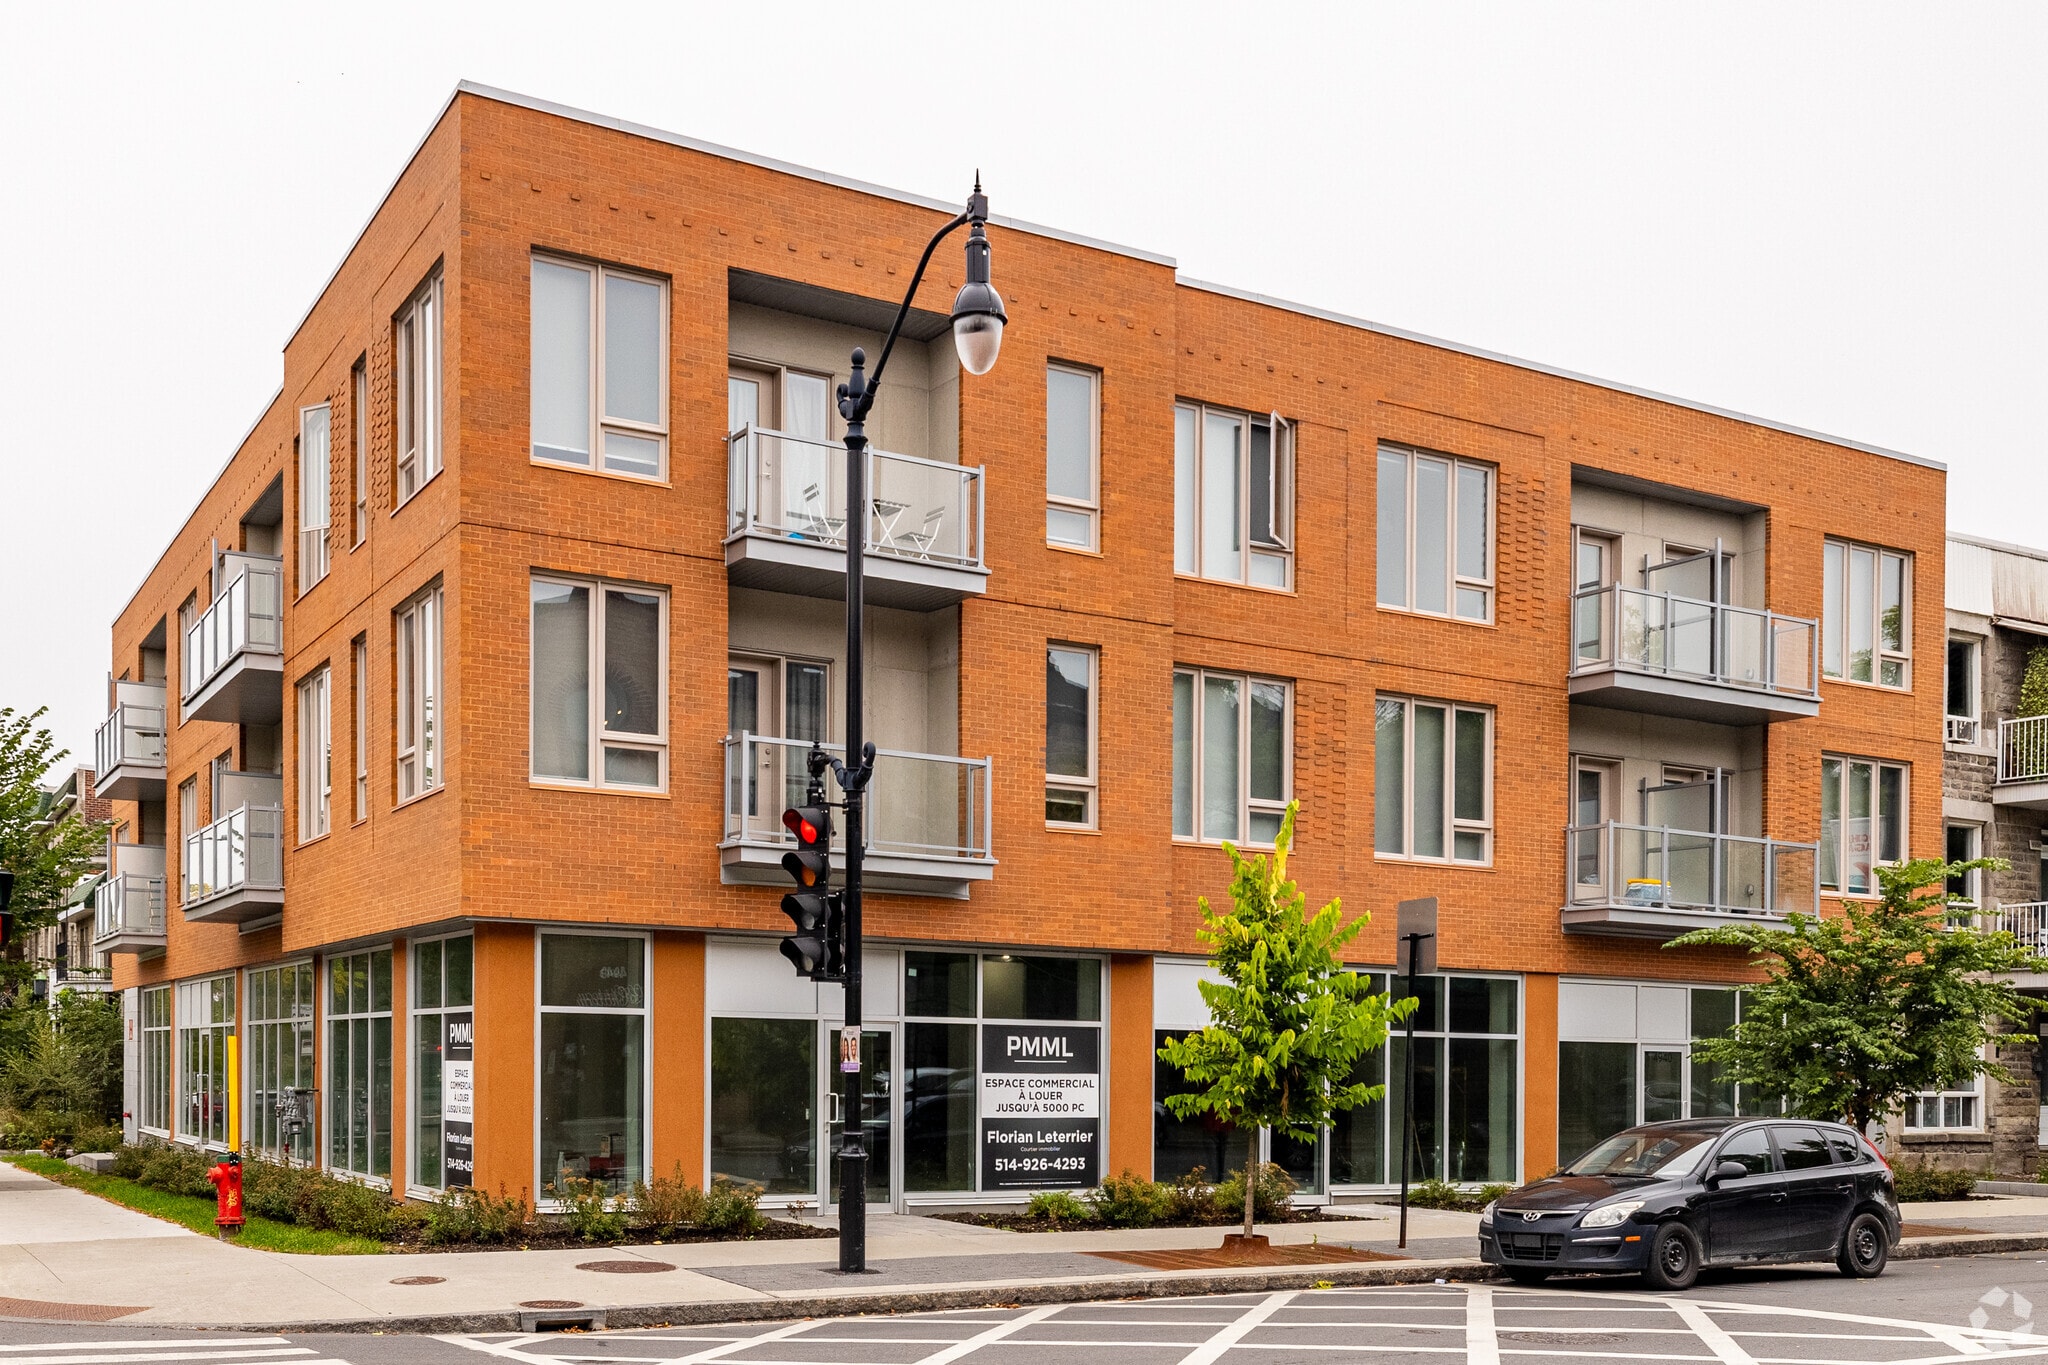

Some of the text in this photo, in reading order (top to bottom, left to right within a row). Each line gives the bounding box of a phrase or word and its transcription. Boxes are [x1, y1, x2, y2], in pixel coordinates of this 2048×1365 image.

[450, 1023, 472, 1043] PMML
[1006, 1035, 1074, 1057] PMML
[985, 1079, 1095, 1088] ESPACE COMMERCIAL
[1018, 1089, 1063, 1100] À LOUER
[995, 1102, 1085, 1113] JUSQU'À 5000 PC
[446, 1132, 459, 1144] Florian
[987, 1130, 1094, 1143] Florian Leterrier
[447, 1158, 473, 1172] 514-926-429
[995, 1157, 1086, 1171] 514-926-4293
